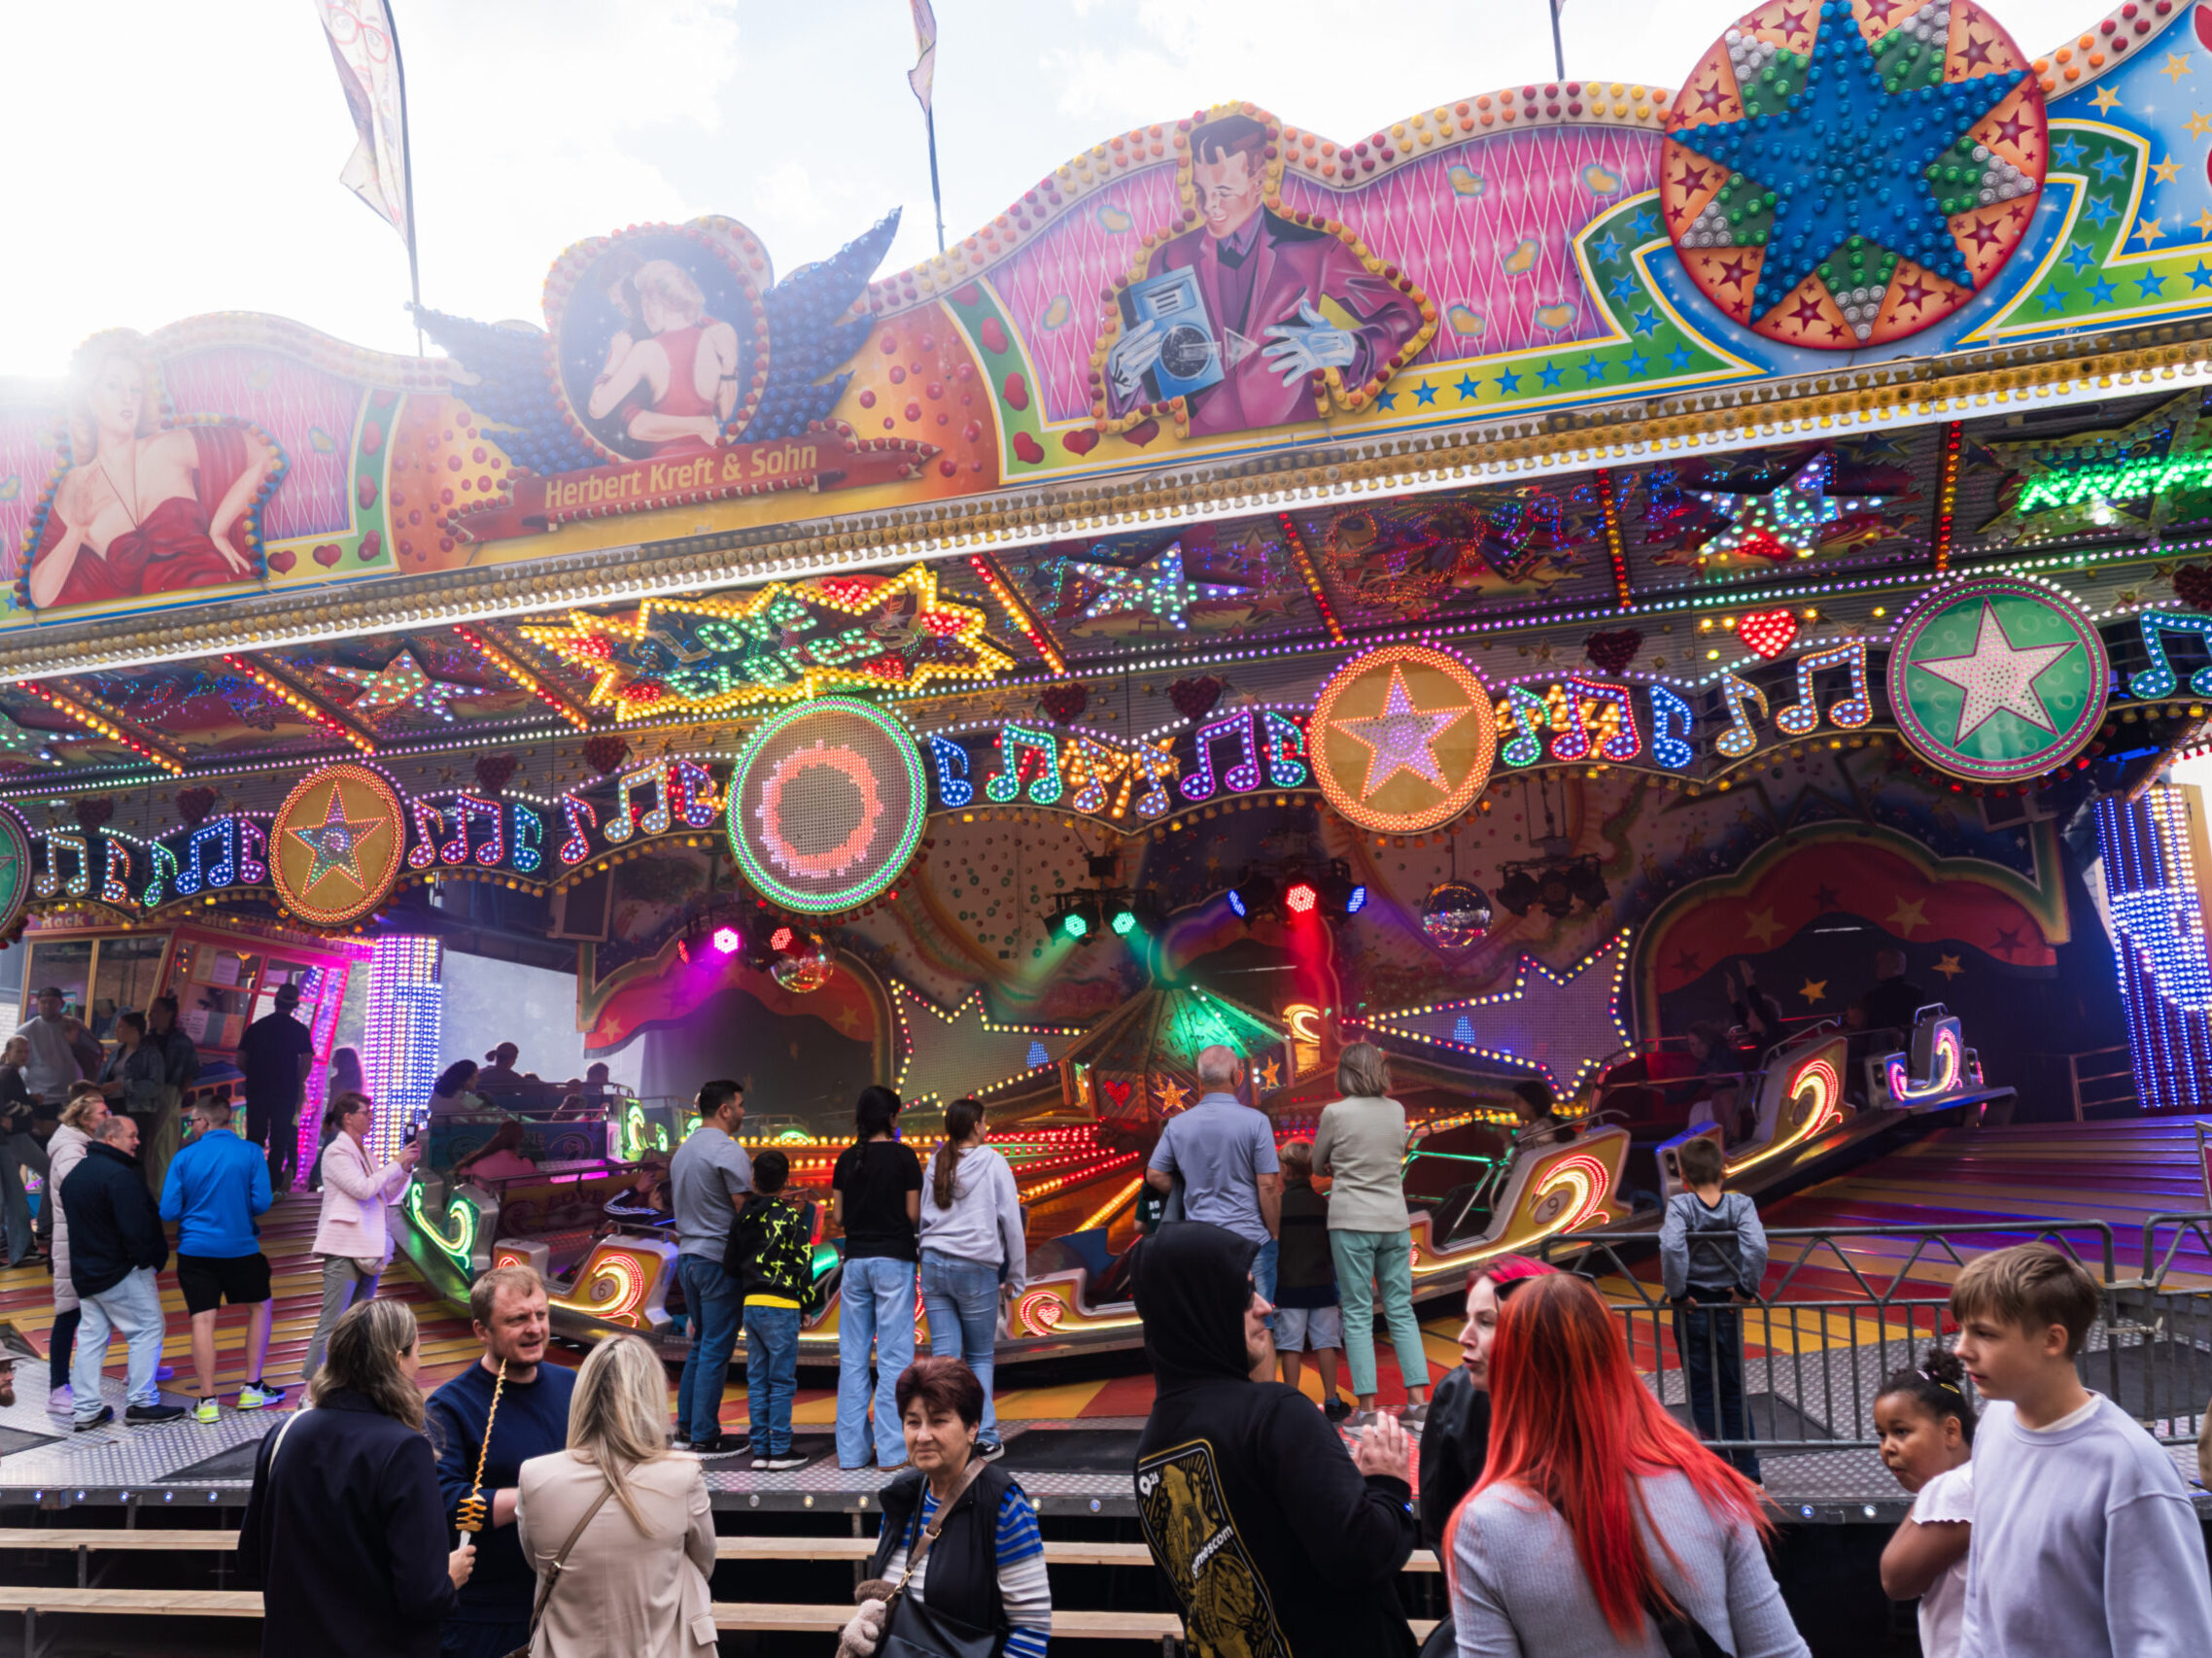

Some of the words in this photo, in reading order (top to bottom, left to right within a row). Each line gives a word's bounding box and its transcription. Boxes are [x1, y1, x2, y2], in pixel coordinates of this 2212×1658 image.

[545, 470, 641, 508] Herbert
[649, 457, 713, 493] Kreft
[721, 453, 743, 481] &
[749, 443, 817, 478] Sohn
[1547, 1196, 1560, 1212] 9
[597, 1282, 607, 1298] 6
